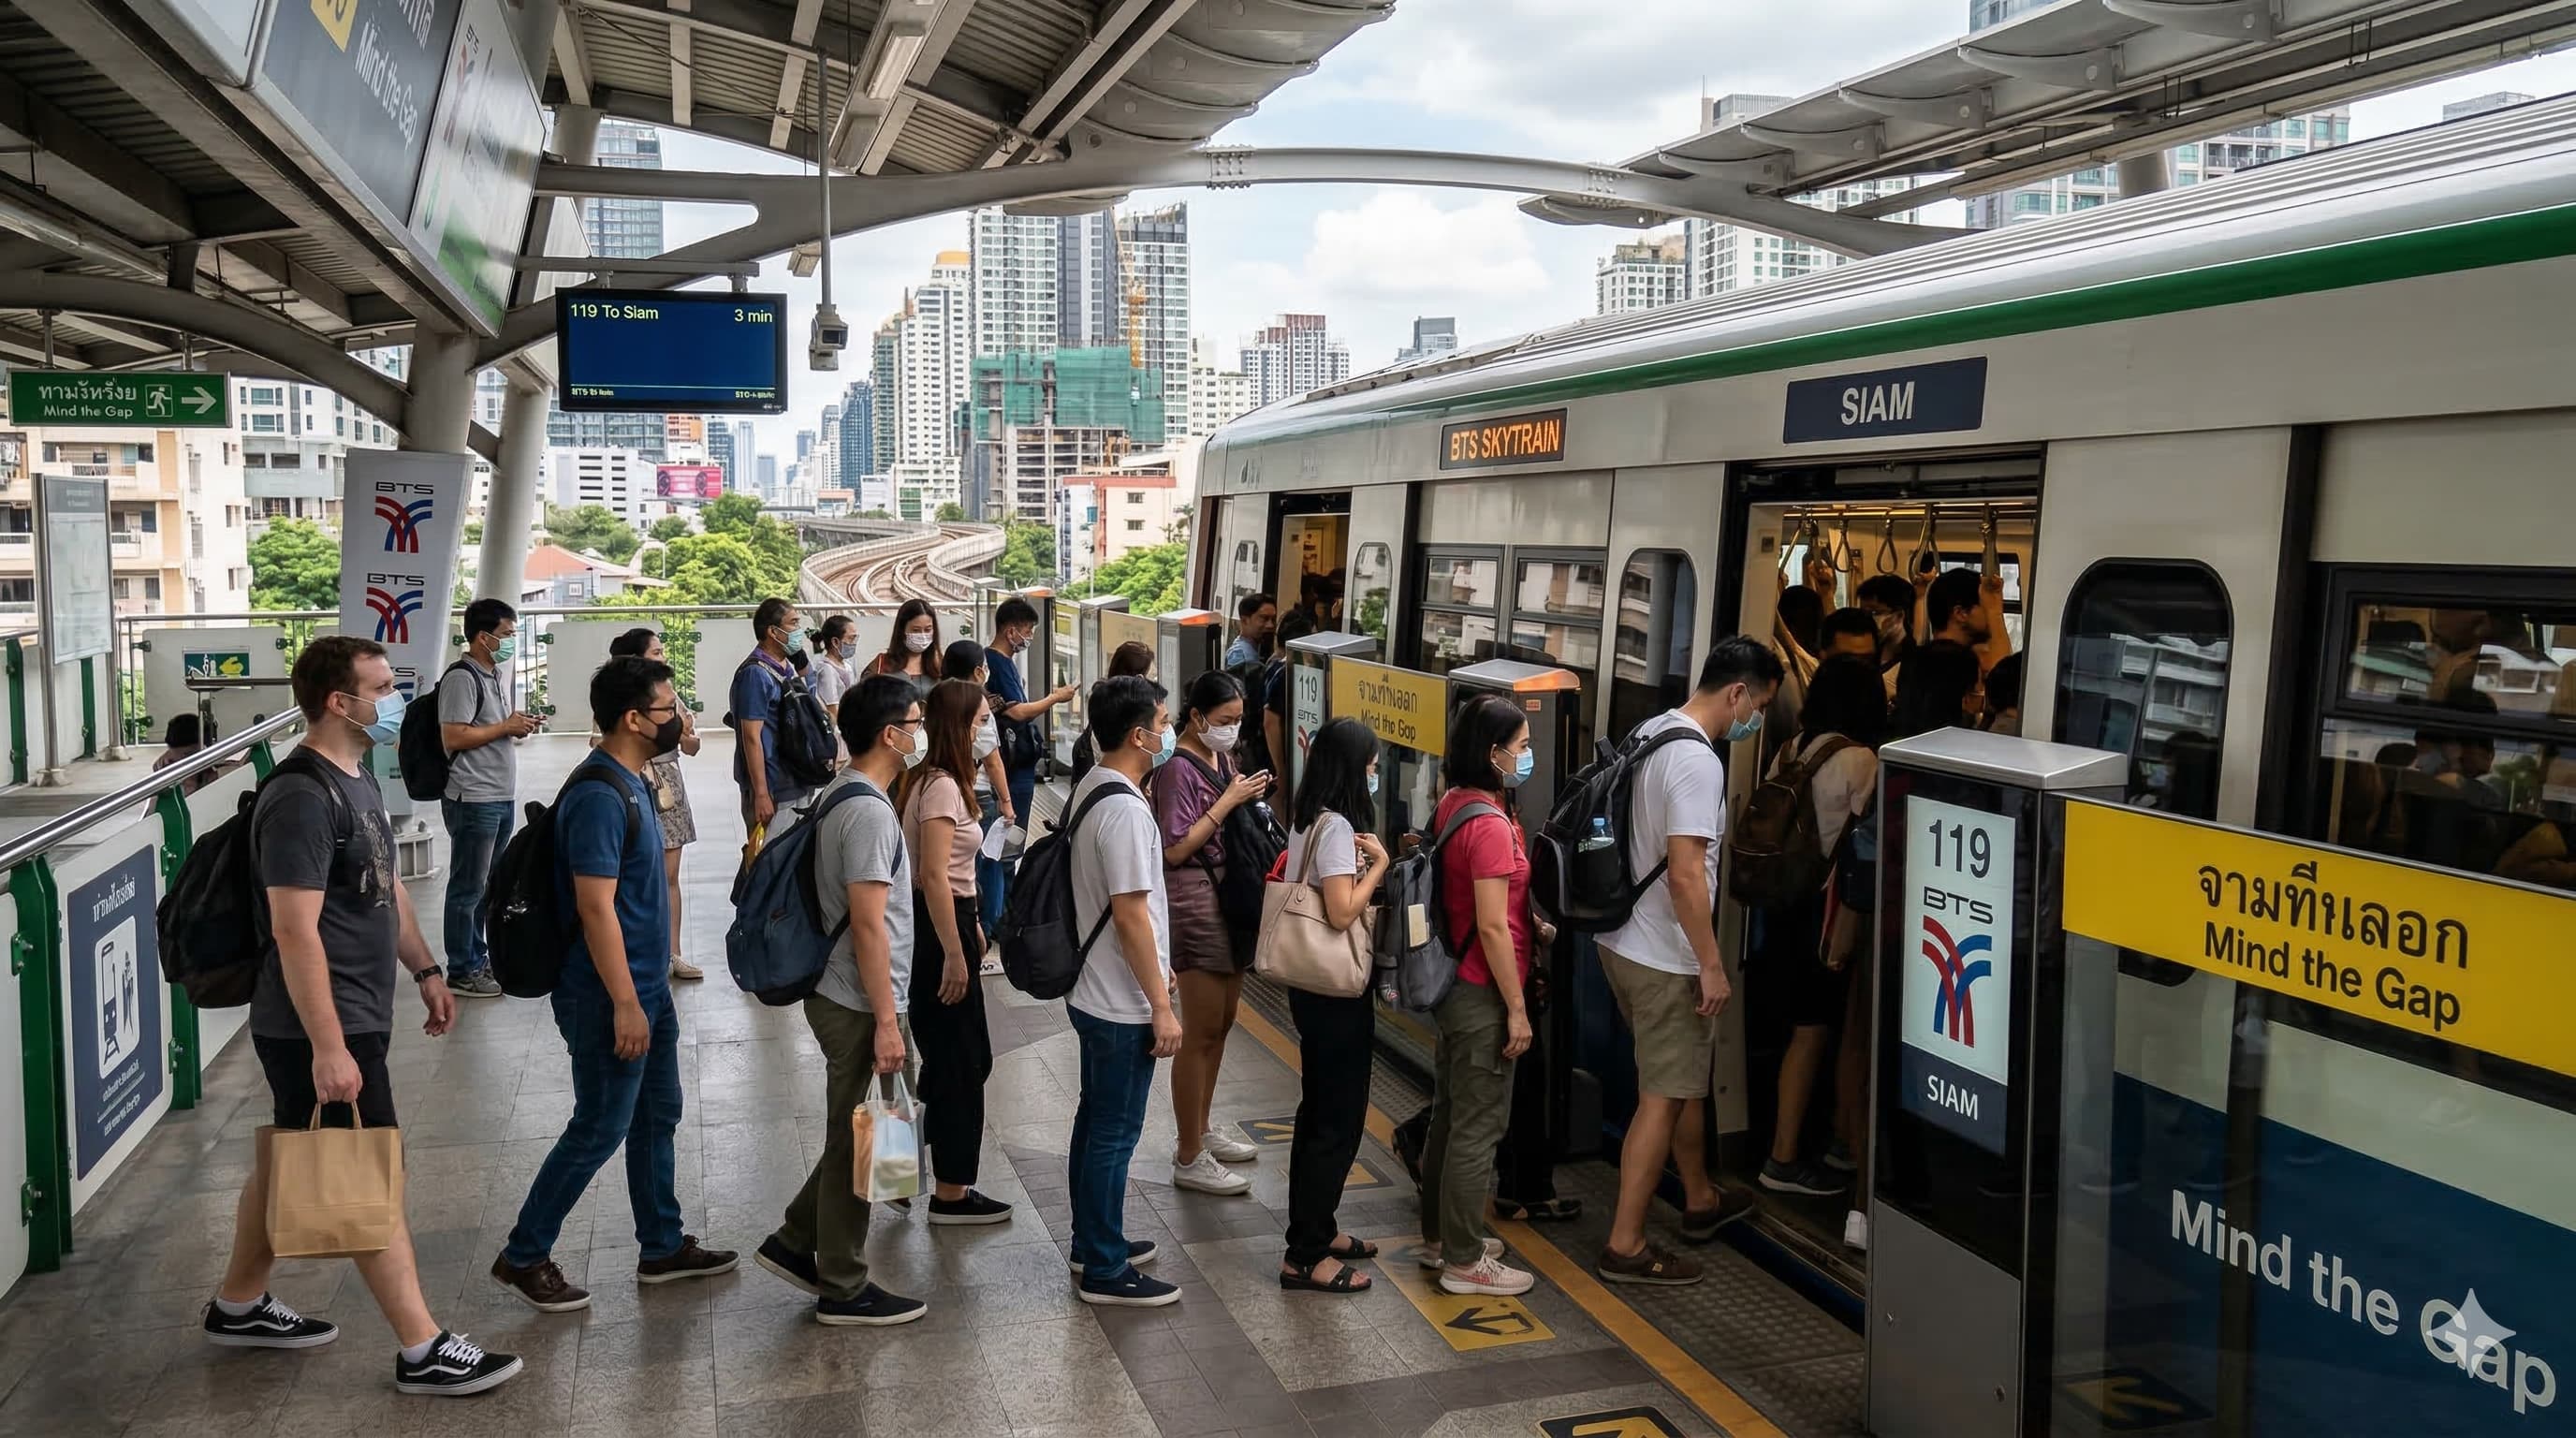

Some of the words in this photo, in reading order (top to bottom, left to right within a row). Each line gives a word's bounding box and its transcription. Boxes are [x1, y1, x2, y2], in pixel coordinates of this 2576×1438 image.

[355, 21, 389, 97] Mind
[382, 60, 401, 121] the
[399, 83, 417, 151] Gap
[570, 304, 597, 317] 119
[602, 304, 620, 318] To
[623, 305, 659, 319] Siam
[734, 309, 743, 322] 3
[748, 310, 773, 323] min
[105, 405, 133, 419] Gap
[1840, 381, 1915, 426] SIAM
[1450, 430, 1478, 462] BTS
[1481, 418, 1560, 459] SKYTRAIN
[375, 481, 433, 494] BTS
[367, 573, 425, 586] BTS
[1298, 674, 1317, 702] 119
[1398, 719, 1416, 743] Gap
[1928, 819, 1992, 878] 119
[1924, 886, 1993, 925] BTS
[2204, 920, 2290, 979] Mind
[2302, 947, 2363, 998] the
[2375, 966, 2461, 1032] Gap
[1927, 1076, 1979, 1121] SIAM
[2172, 1189, 2291, 1291] Mind
[2308, 1251, 2400, 1336] the
[2419, 1299, 2557, 1416] Gap
